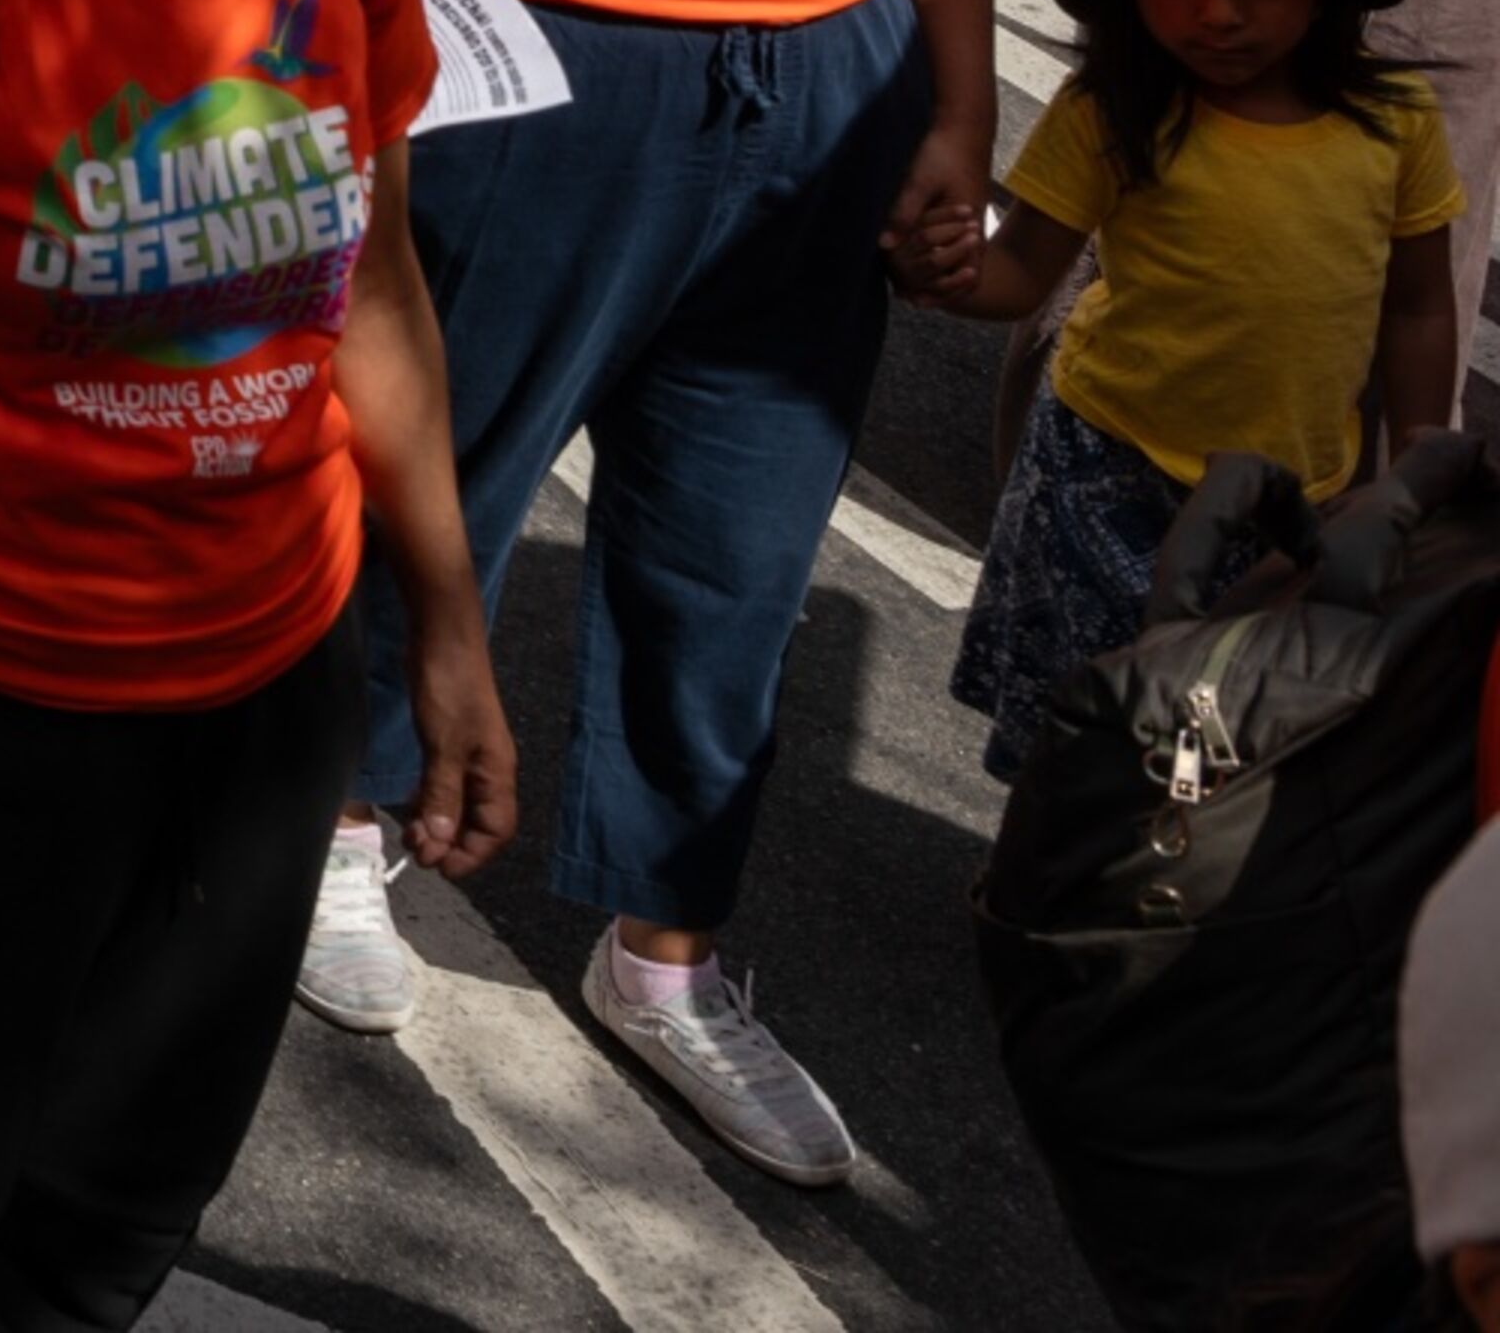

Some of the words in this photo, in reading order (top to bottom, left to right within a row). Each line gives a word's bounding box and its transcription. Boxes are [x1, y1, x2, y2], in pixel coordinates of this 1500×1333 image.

[74, 106, 353, 231] CLIMATE
[55, 381, 200, 409] BUILDING
[208, 378, 228, 402] A
